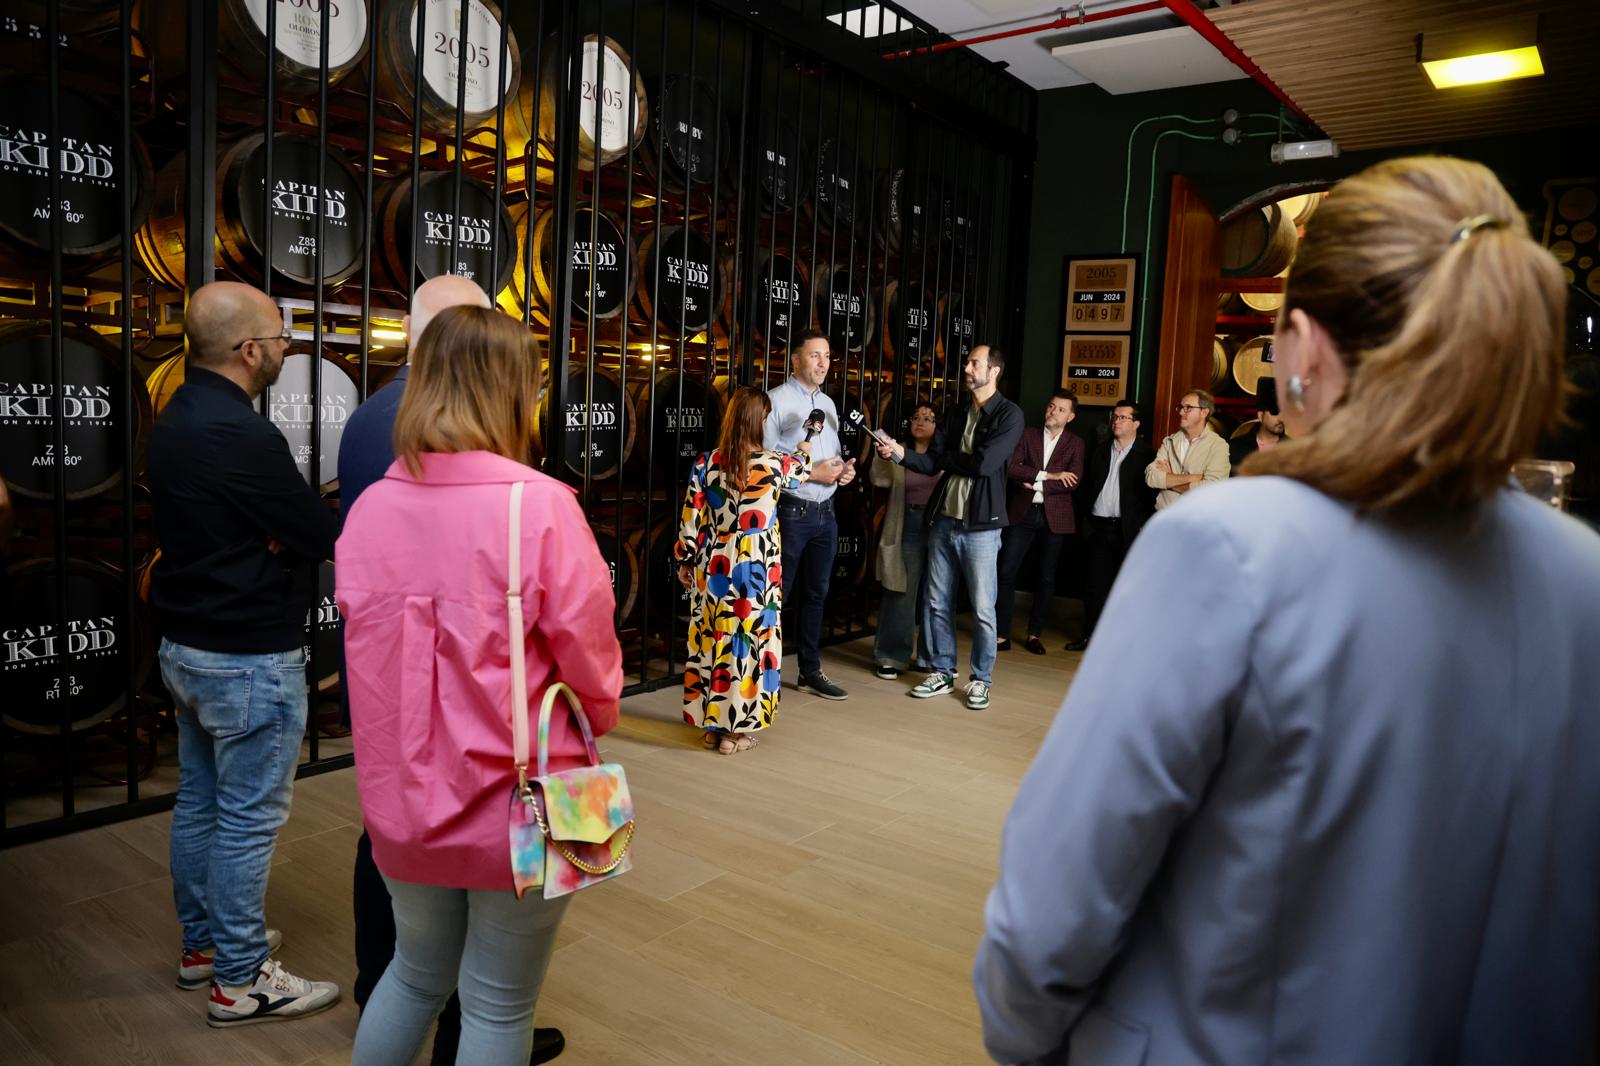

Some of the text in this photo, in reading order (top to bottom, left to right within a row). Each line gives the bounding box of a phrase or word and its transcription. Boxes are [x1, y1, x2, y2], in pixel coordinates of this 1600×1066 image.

[0, 124, 113, 158] CAPTAN
[0, 138, 114, 179] KIDD
[262, 178, 346, 202] APITAN
[424, 211, 491, 228] CAPTAN
[573, 241, 616, 251] APIAN
[667, 263, 709, 285] KDD
[1080, 293, 1121, 302] JUN 2024
[1074, 368, 1116, 377] JUN 2024
[271, 392, 348, 404] APIAN
[0, 395, 112, 419] KIDD
[565, 403, 615, 411] CAPTAN
[45, 444, 69, 456] Z3
[2, 616, 114, 641] CAPTAN
[3, 629, 116, 663] KIDD
[53, 676, 76, 690] Z3
